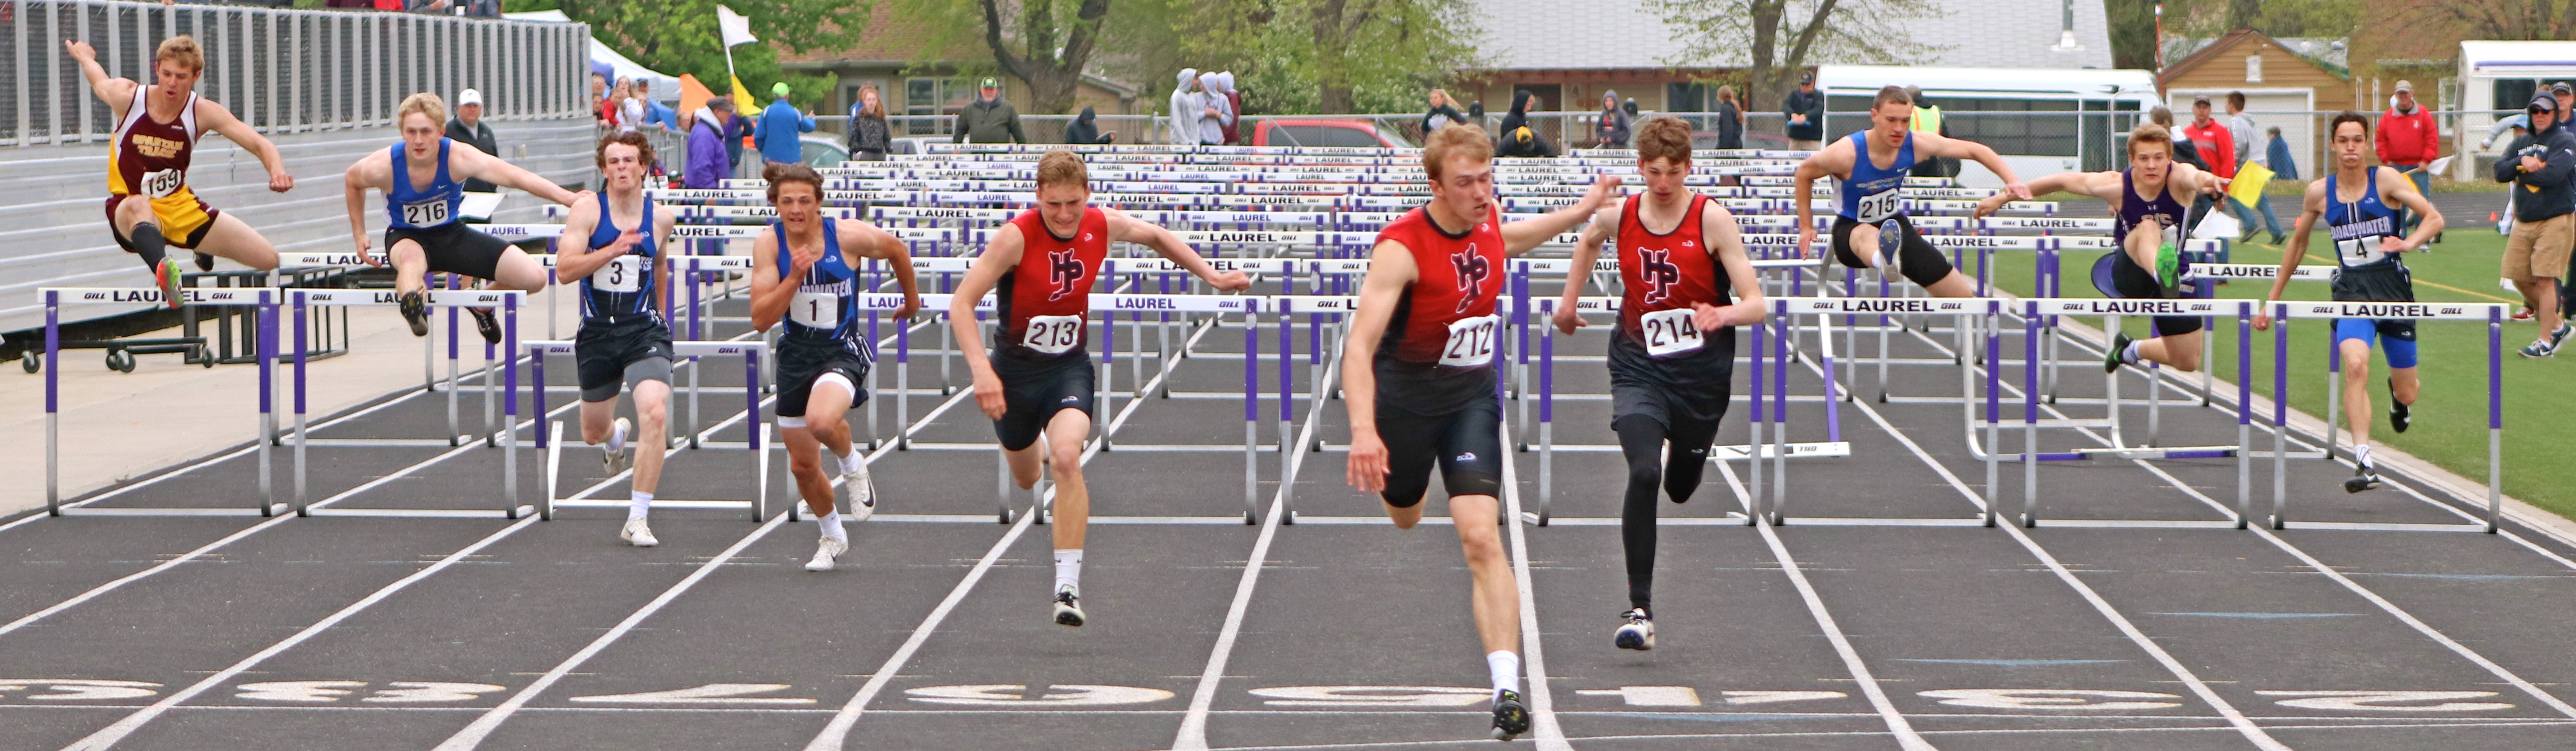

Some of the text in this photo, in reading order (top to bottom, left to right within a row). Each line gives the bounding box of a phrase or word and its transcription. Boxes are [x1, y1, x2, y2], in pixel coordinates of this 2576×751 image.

[132, 134, 184, 150] SPARTAN
[137, 145, 177, 158] TRACK
[148, 169, 178, 195] 159
[407, 202, 445, 224] 216
[1861, 193, 1895, 218] 215
[2356, 240, 2368, 258] 4
[610, 261, 623, 284] 3
[2209, 267, 2280, 277] LAURE
[114, 291, 206, 302] LAUEL
[375, 293, 436, 303] LAUL
[1116, 298, 1176, 309] LAUREL
[1843, 301, 1934, 311] LAUREL
[809, 299, 817, 321] 1
[2092, 302, 2184, 313] LAUREL
[2342, 305, 2434, 316] LAUREL
[1029, 321, 1077, 346] 213
[1447, 321, 1493, 358] 212
[1647, 314, 1697, 347] 214
[235, 680, 506, 702] 8
[569, 683, 818, 704] 7
[1247, 685, 1495, 706] 5
[1575, 686, 1847, 706] 4
[1915, 688, 2182, 709] 3
[2254, 690, 2515, 711] 2
